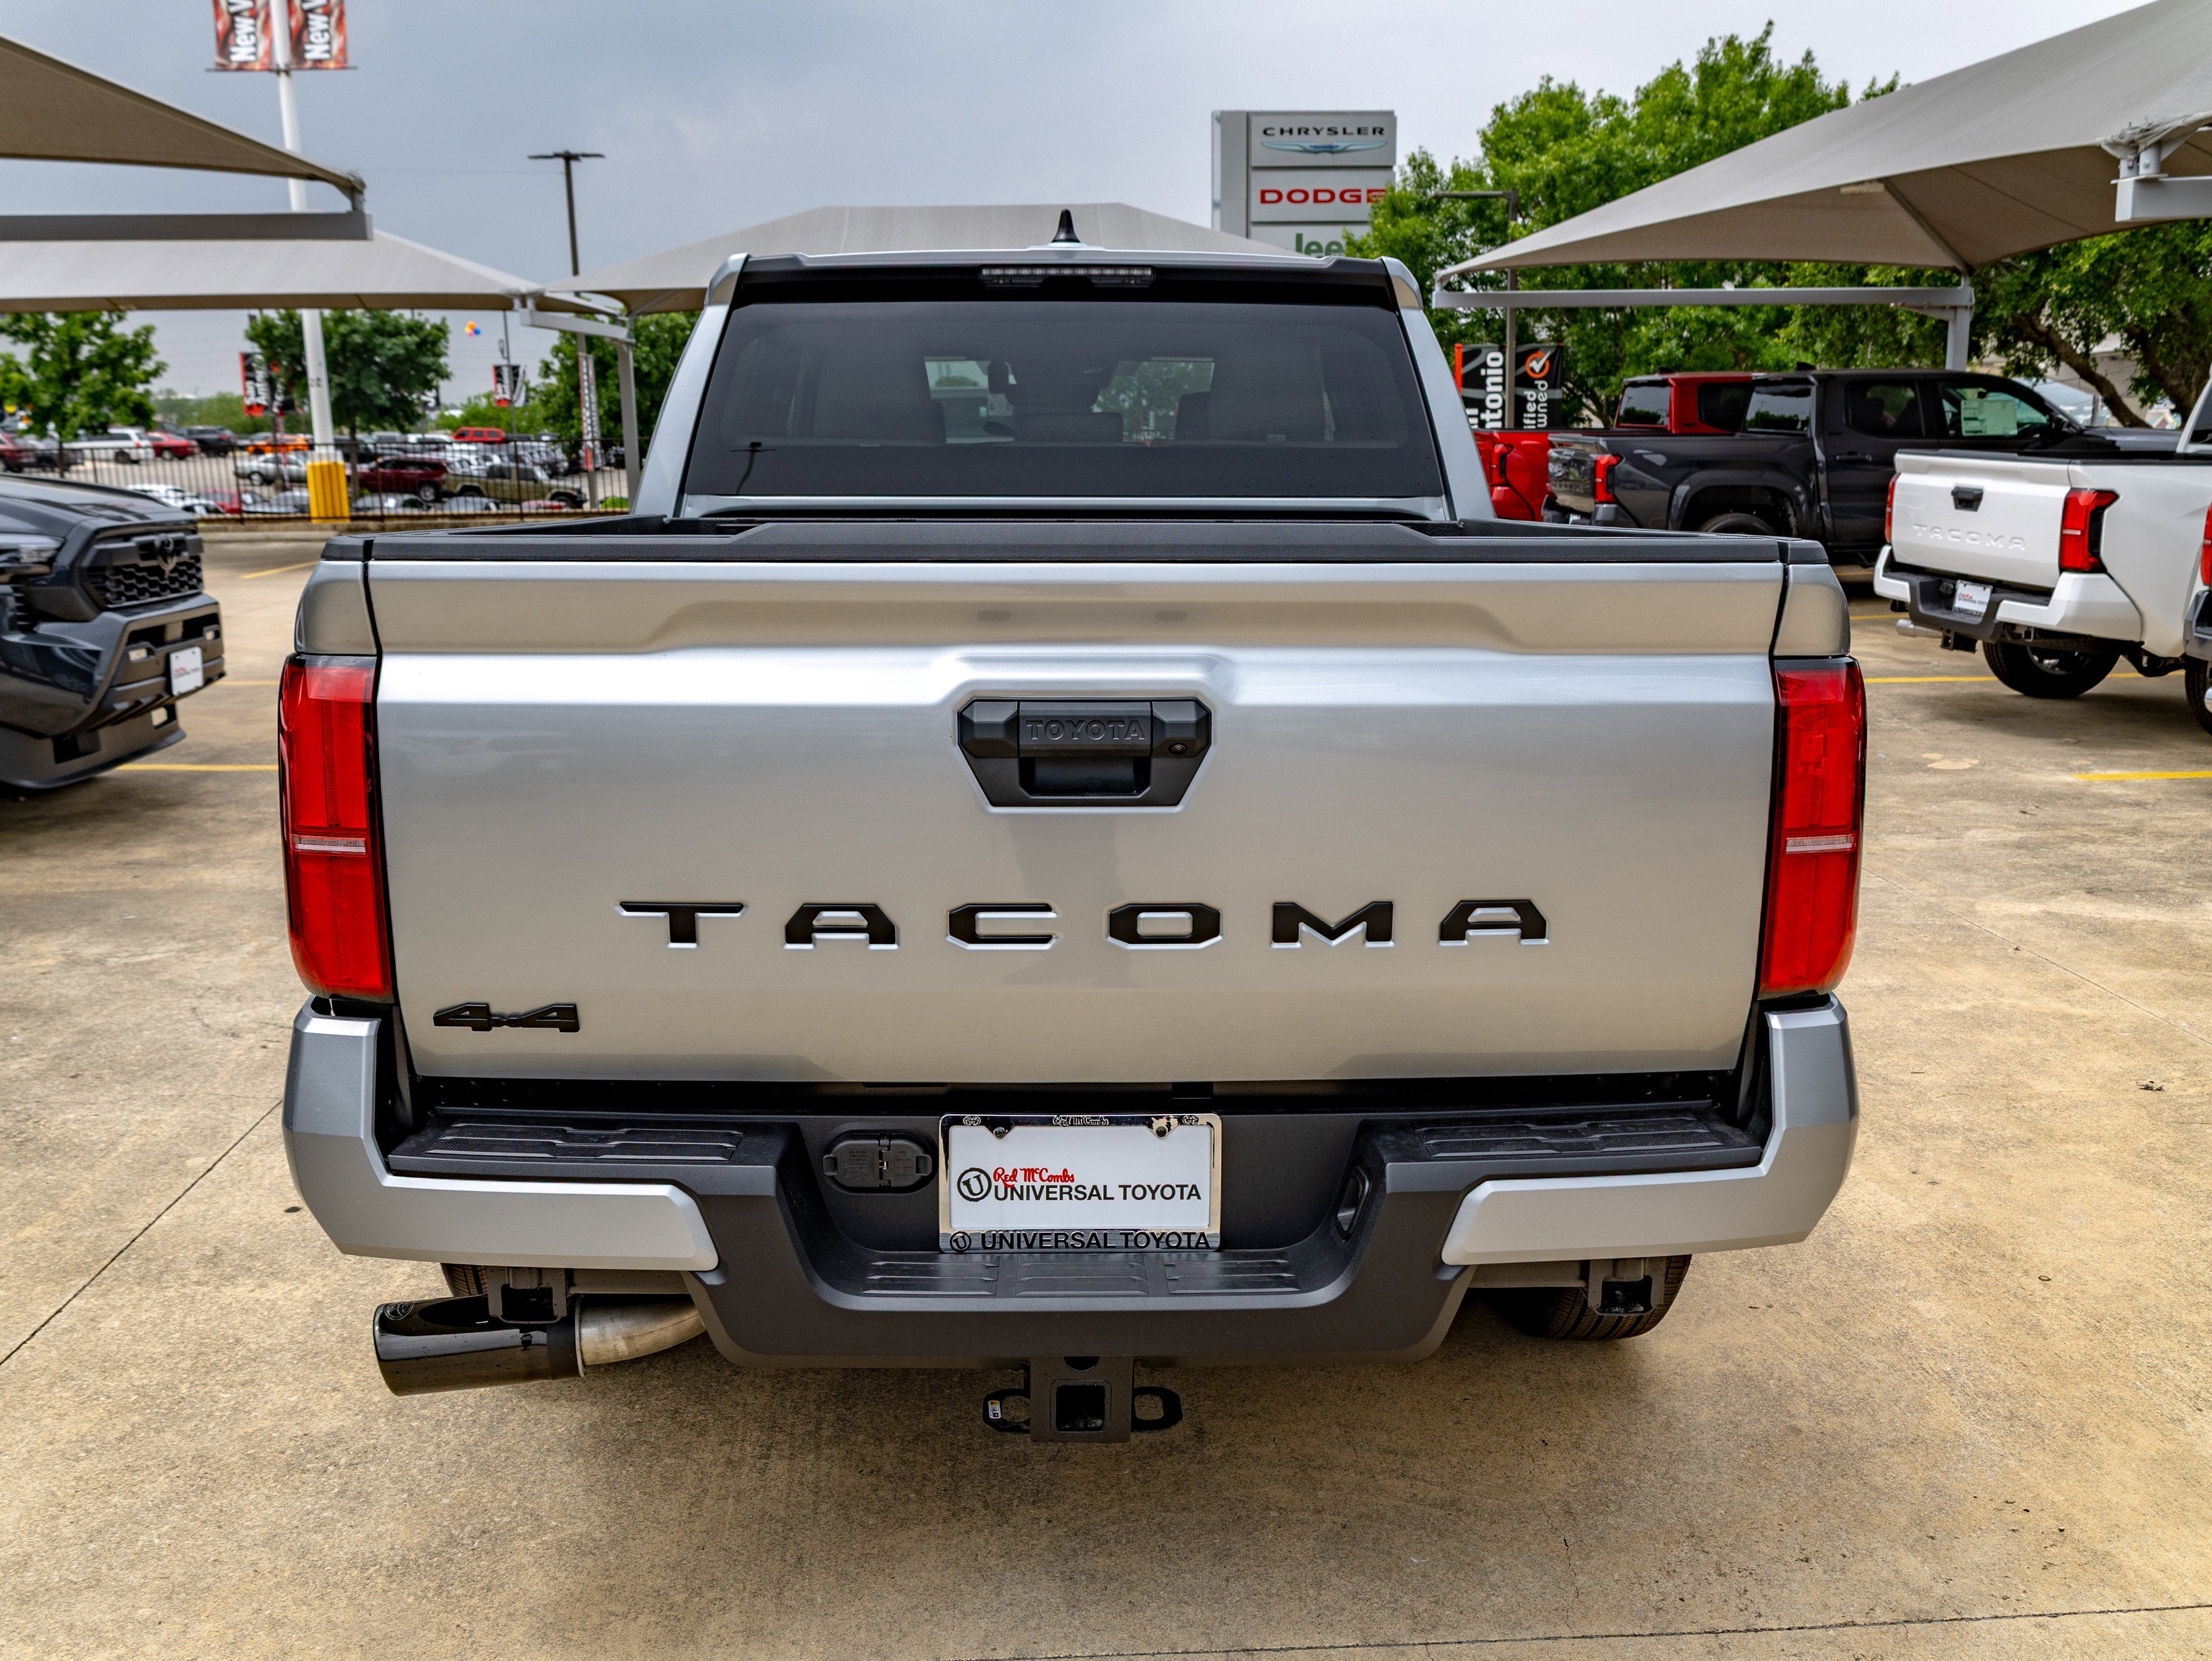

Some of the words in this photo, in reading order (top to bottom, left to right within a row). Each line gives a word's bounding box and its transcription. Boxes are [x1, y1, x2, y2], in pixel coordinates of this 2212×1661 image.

[230, 16, 256, 62] New
[304, 12, 331, 60] New
[1263, 126, 1385, 136] CHRYSLER
[1260, 189, 1387, 205] DODGE
[1296, 233, 1344, 257] Jee
[1522, 391, 1537, 429] ified
[1534, 380, 1548, 428] wned
[1912, 523, 2026, 551] TACOMA
[1026, 720, 1146, 740] TOYOTA
[613, 900, 1550, 951] TACOMA
[1052, 1115, 1071, 1127] Red
[993, 1167, 1018, 1188] Red
[1019, 1167, 1075, 1183] McCombs
[994, 1185, 1115, 1201] UNIVERSAL
[1118, 1184, 1202, 1200] TOYOTA
[981, 1231, 1116, 1250] UNIVERSAL
[1119, 1231, 1210, 1249] TOYOTA
